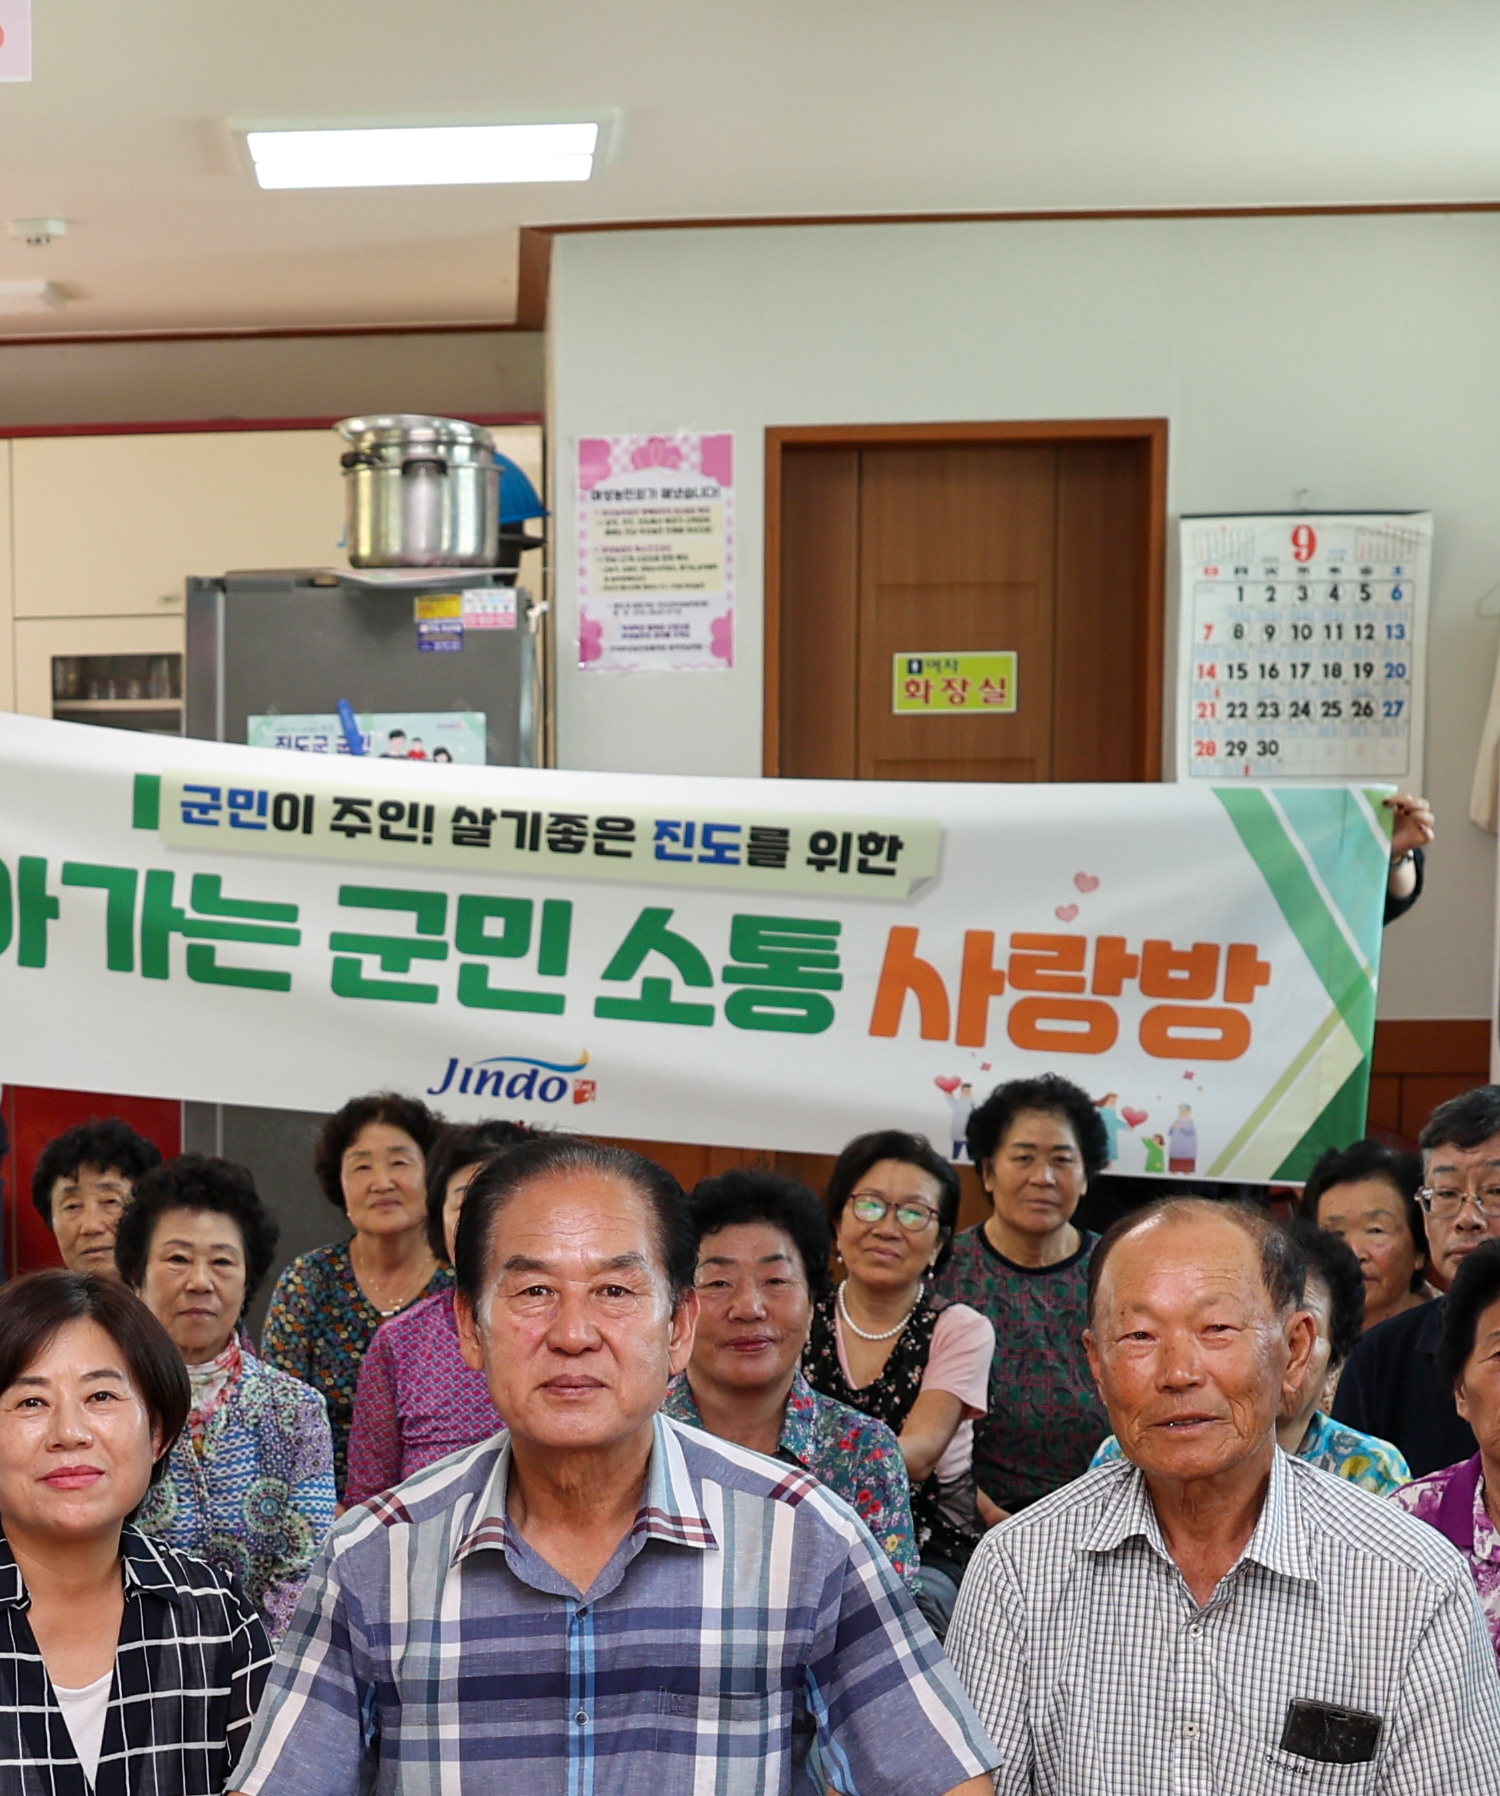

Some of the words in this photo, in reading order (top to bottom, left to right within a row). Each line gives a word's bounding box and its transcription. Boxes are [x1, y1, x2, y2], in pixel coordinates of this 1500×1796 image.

[1291, 524, 1318, 563] 9
[1238, 586, 1244, 602] 1
[1267, 586, 1276, 602] 2
[1298, 585, 1308, 602] 3
[1329, 584, 1339, 602] 4
[1360, 583, 1372, 602] 5
[1391, 585, 1403, 602] 6
[1204, 624, 1215, 640] 7
[1233, 623, 1244, 640] 8
[1264, 624, 1276, 641] 9
[1292, 624, 1313, 641] 10
[1324, 624, 1343, 641] 11
[1355, 623, 1375, 641] 12
[1386, 624, 1406, 640] 13
[1197, 663, 1217, 679] 14
[1227, 663, 1248, 680] 15
[1259, 663, 1280, 680] 16
[1291, 663, 1311, 679] 17
[1323, 662, 1343, 679] 18
[1354, 662, 1374, 679] 19
[1384, 663, 1406, 679] 20
[1197, 702, 1217, 719] 21
[1226, 702, 1248, 718] 22
[1257, 701, 1280, 719] 23
[1289, 701, 1311, 718] 24
[1321, 701, 1342, 718] 25
[1351, 700, 1374, 719] 26
[1383, 701, 1405, 718] 27
[1195, 741, 1217, 757] 28
[1225, 741, 1248, 757] 29
[1257, 740, 1279, 757] 30
[181, 785, 314, 835] 군민이
[330, 797, 435, 845] 주인!
[451, 806, 636, 859] 살기좋은
[653, 820, 790, 869] 진도를
[805, 830, 904, 877] 위한
[331, 886, 572, 1015] 군민
[595, 908, 843, 1034] 소통
[870, 926, 1270, 1061] 사랑방
[427, 1057, 568, 1103] Jindo
